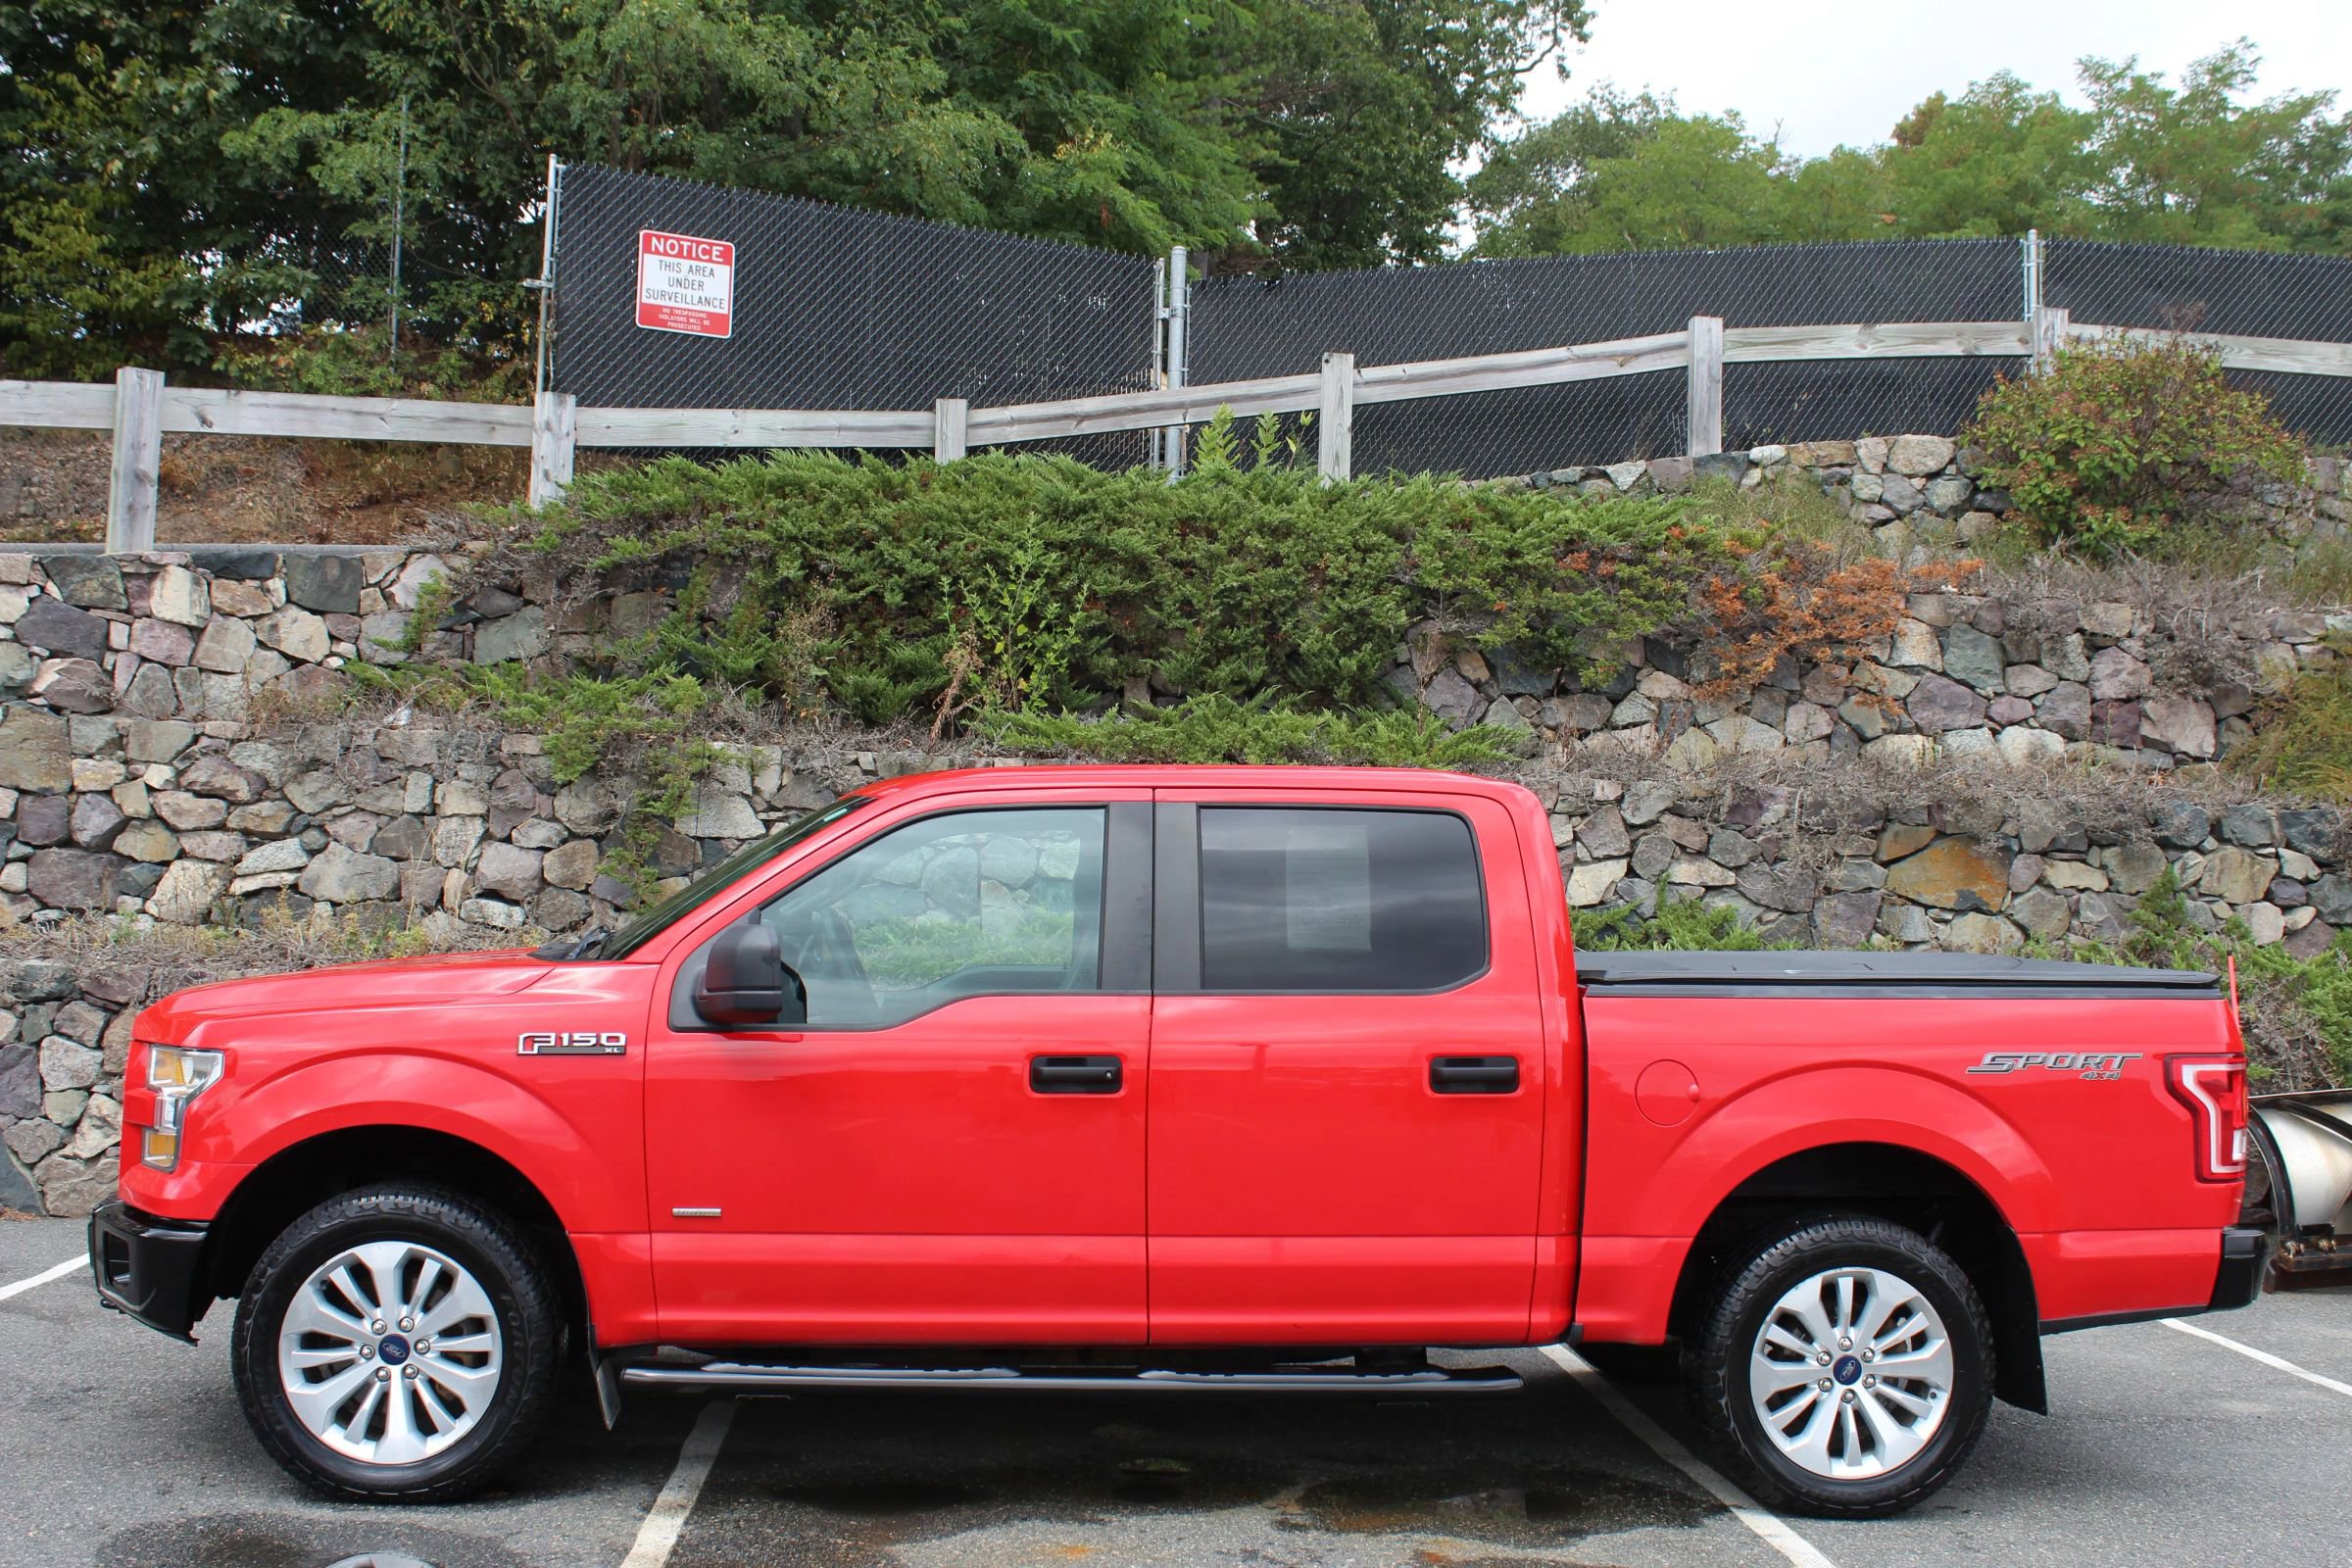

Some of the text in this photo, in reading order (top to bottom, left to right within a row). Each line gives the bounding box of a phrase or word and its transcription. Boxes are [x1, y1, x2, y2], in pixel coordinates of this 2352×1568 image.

[651, 236, 724, 263] NOTICE
[659, 260, 715, 279] THIS AREA
[667, 276, 705, 292] UNDER
[645, 288, 725, 310] SURVEILLANCE
[659, 314, 687, 323] VIOLATORS
[672, 308, 708, 318] TRESPASSING
[667, 321, 702, 331] PROSECUTED
[1965, 1053, 2143, 1074] SPORT
